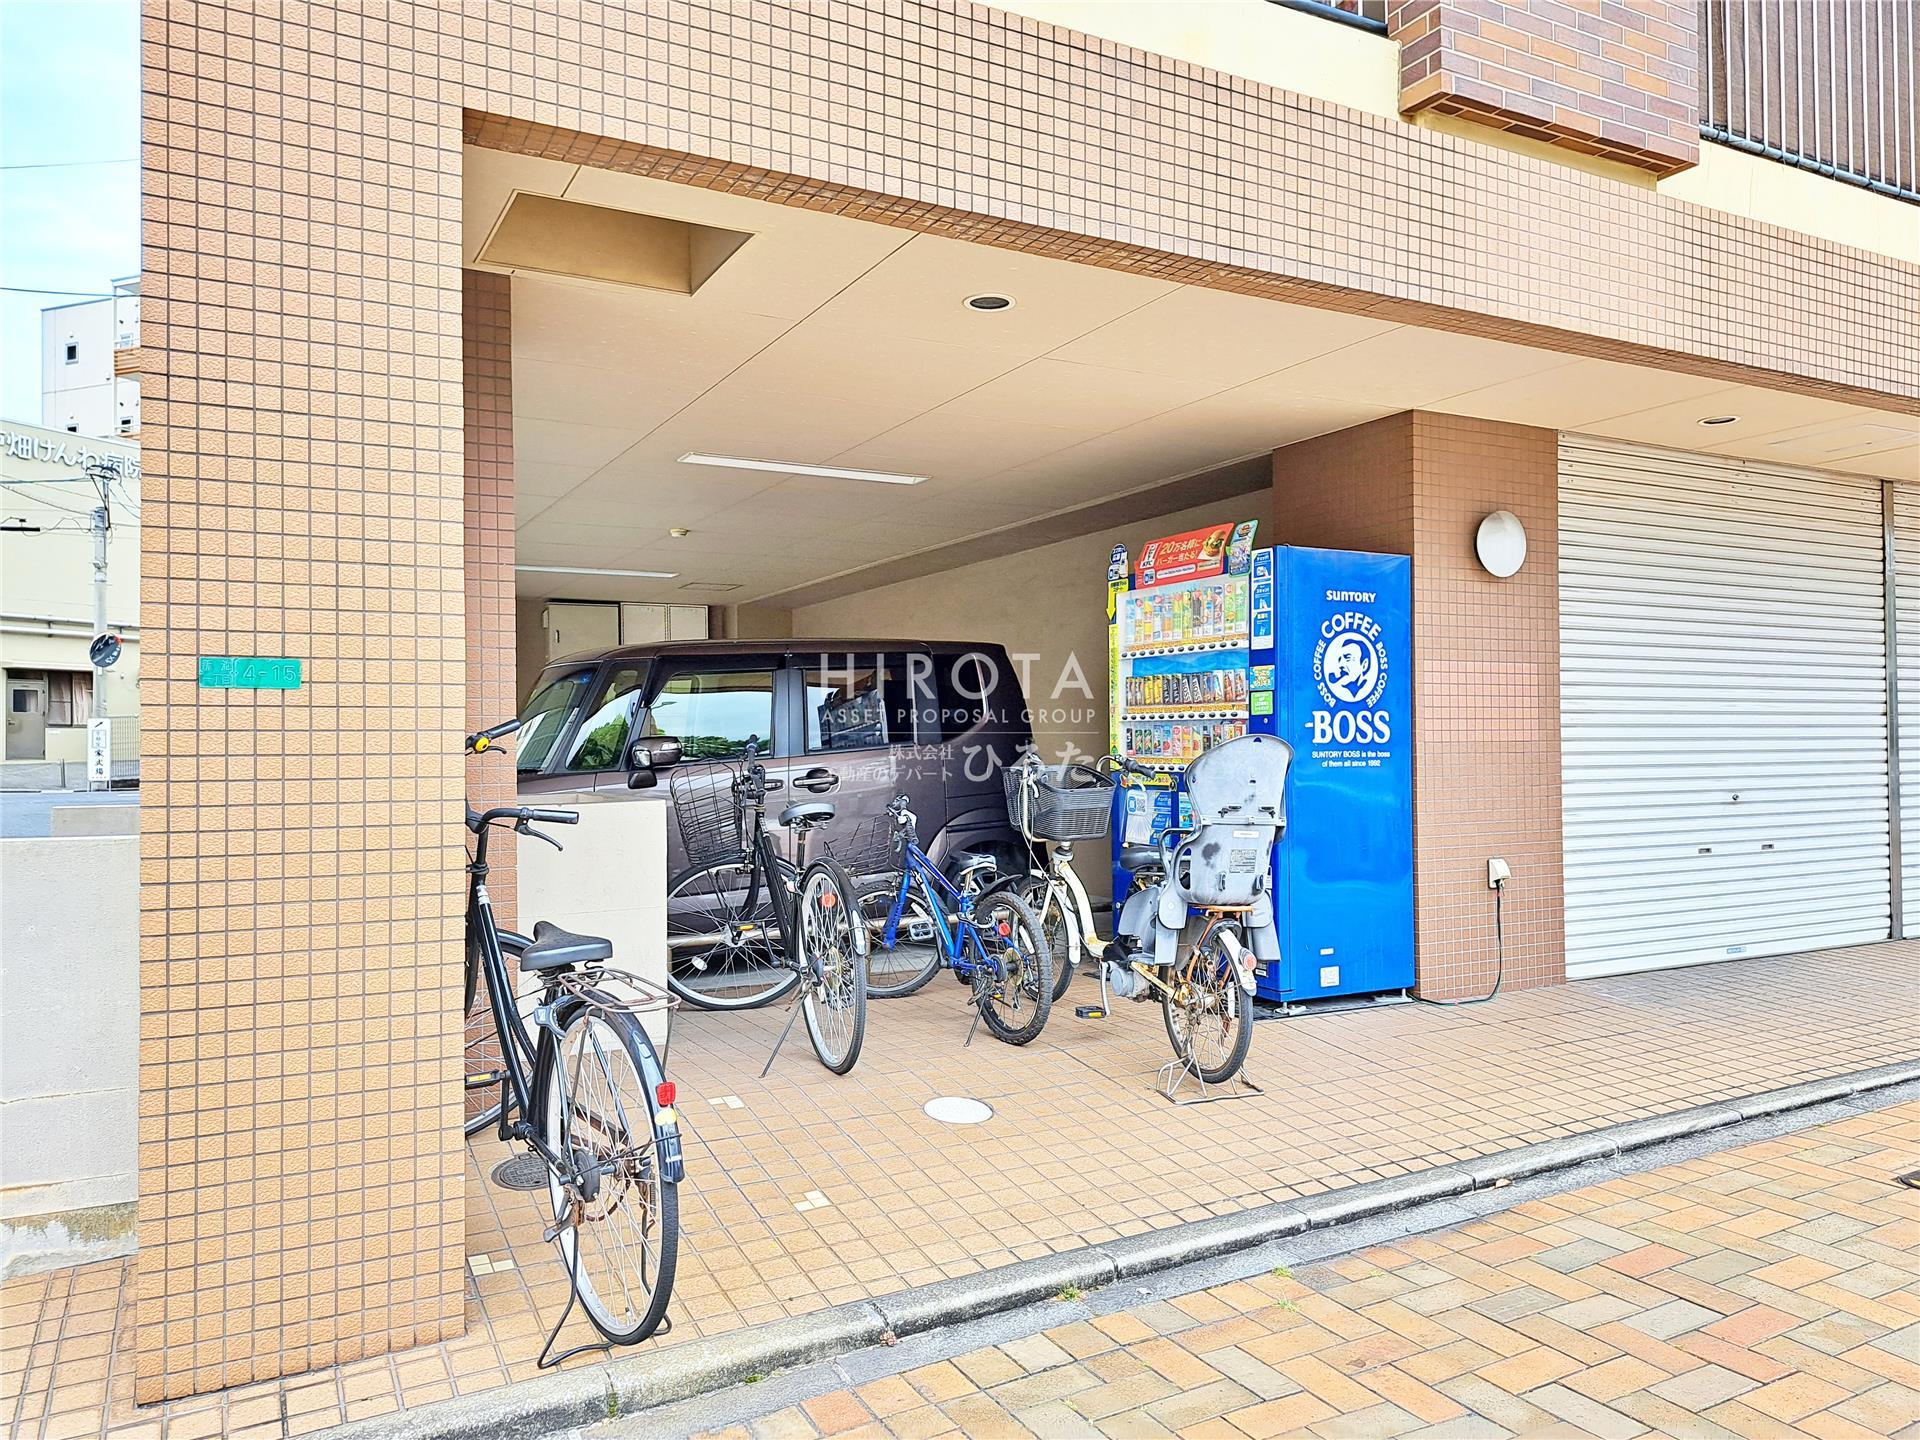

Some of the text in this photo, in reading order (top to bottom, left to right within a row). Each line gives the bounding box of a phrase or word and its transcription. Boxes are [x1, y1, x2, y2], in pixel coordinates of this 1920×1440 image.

[1326, 590, 1376, 603] SUNTORY
[1321, 612, 1382, 641] COFFEE
[243, 664, 297, 681] 4-15
[1313, 639, 1336, 708] BOSS COFFEE
[1366, 641, 1388, 708] BOSS COFFEE
[1312, 710, 1391, 744] BOSS
